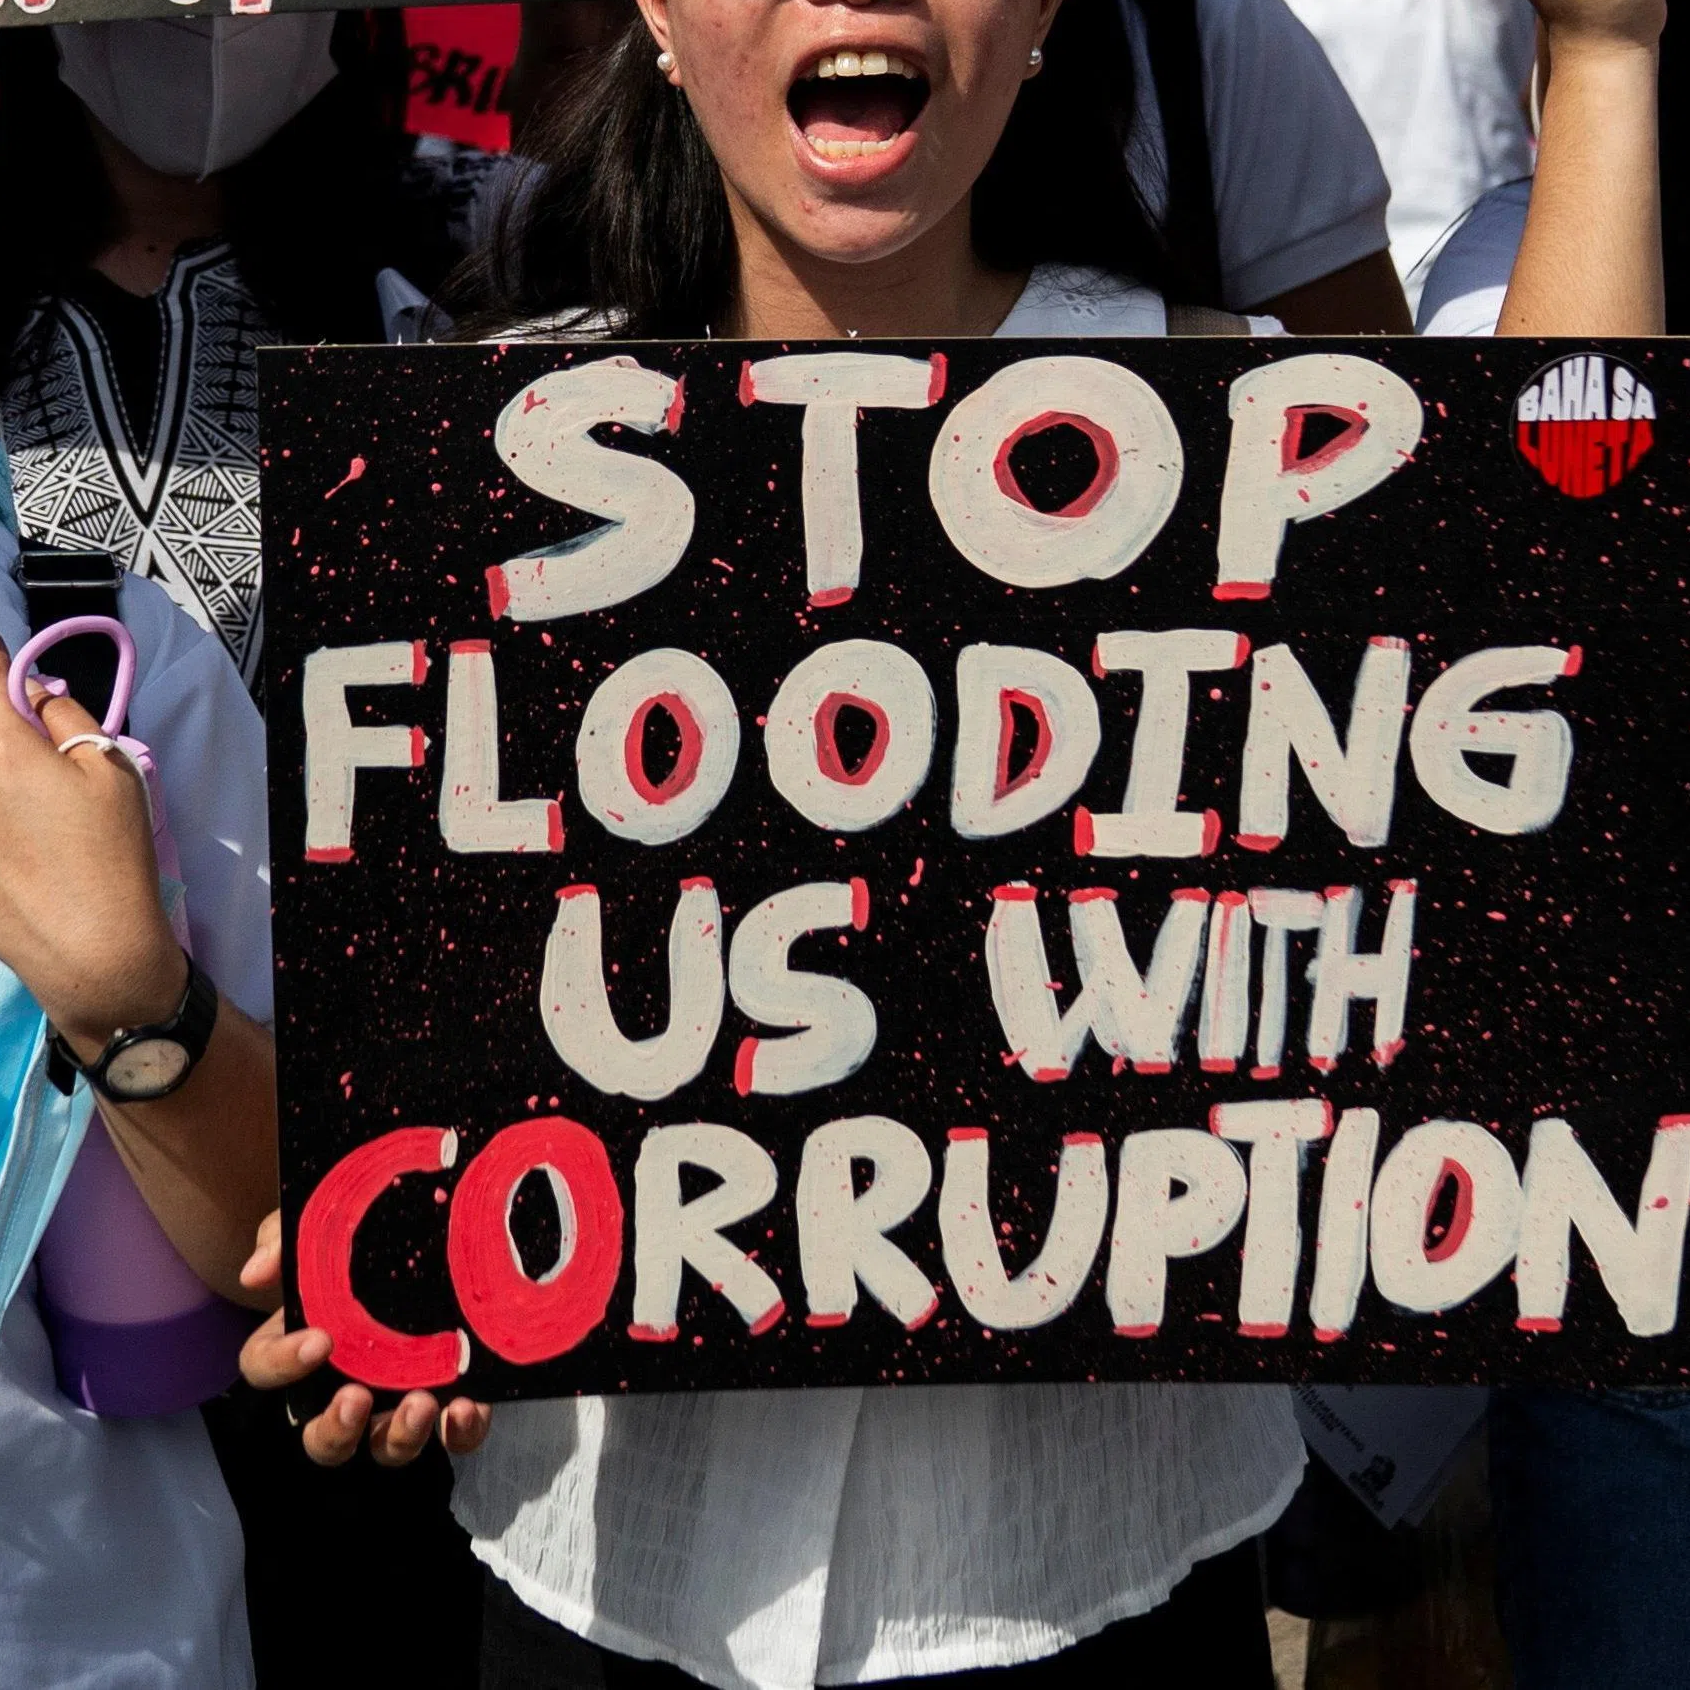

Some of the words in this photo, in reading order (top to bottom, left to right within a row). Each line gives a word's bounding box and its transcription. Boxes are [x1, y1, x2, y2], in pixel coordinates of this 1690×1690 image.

[484, 353, 1424, 623] STOP
[1517, 420, 1655, 499] LUNETA
[1518, 355, 1607, 421] BAHA
[1611, 366, 1656, 421] SA
[301, 628, 1584, 864] FLOODING
[540, 875, 878, 1101] US
[987, 877, 1420, 1084] WITH
